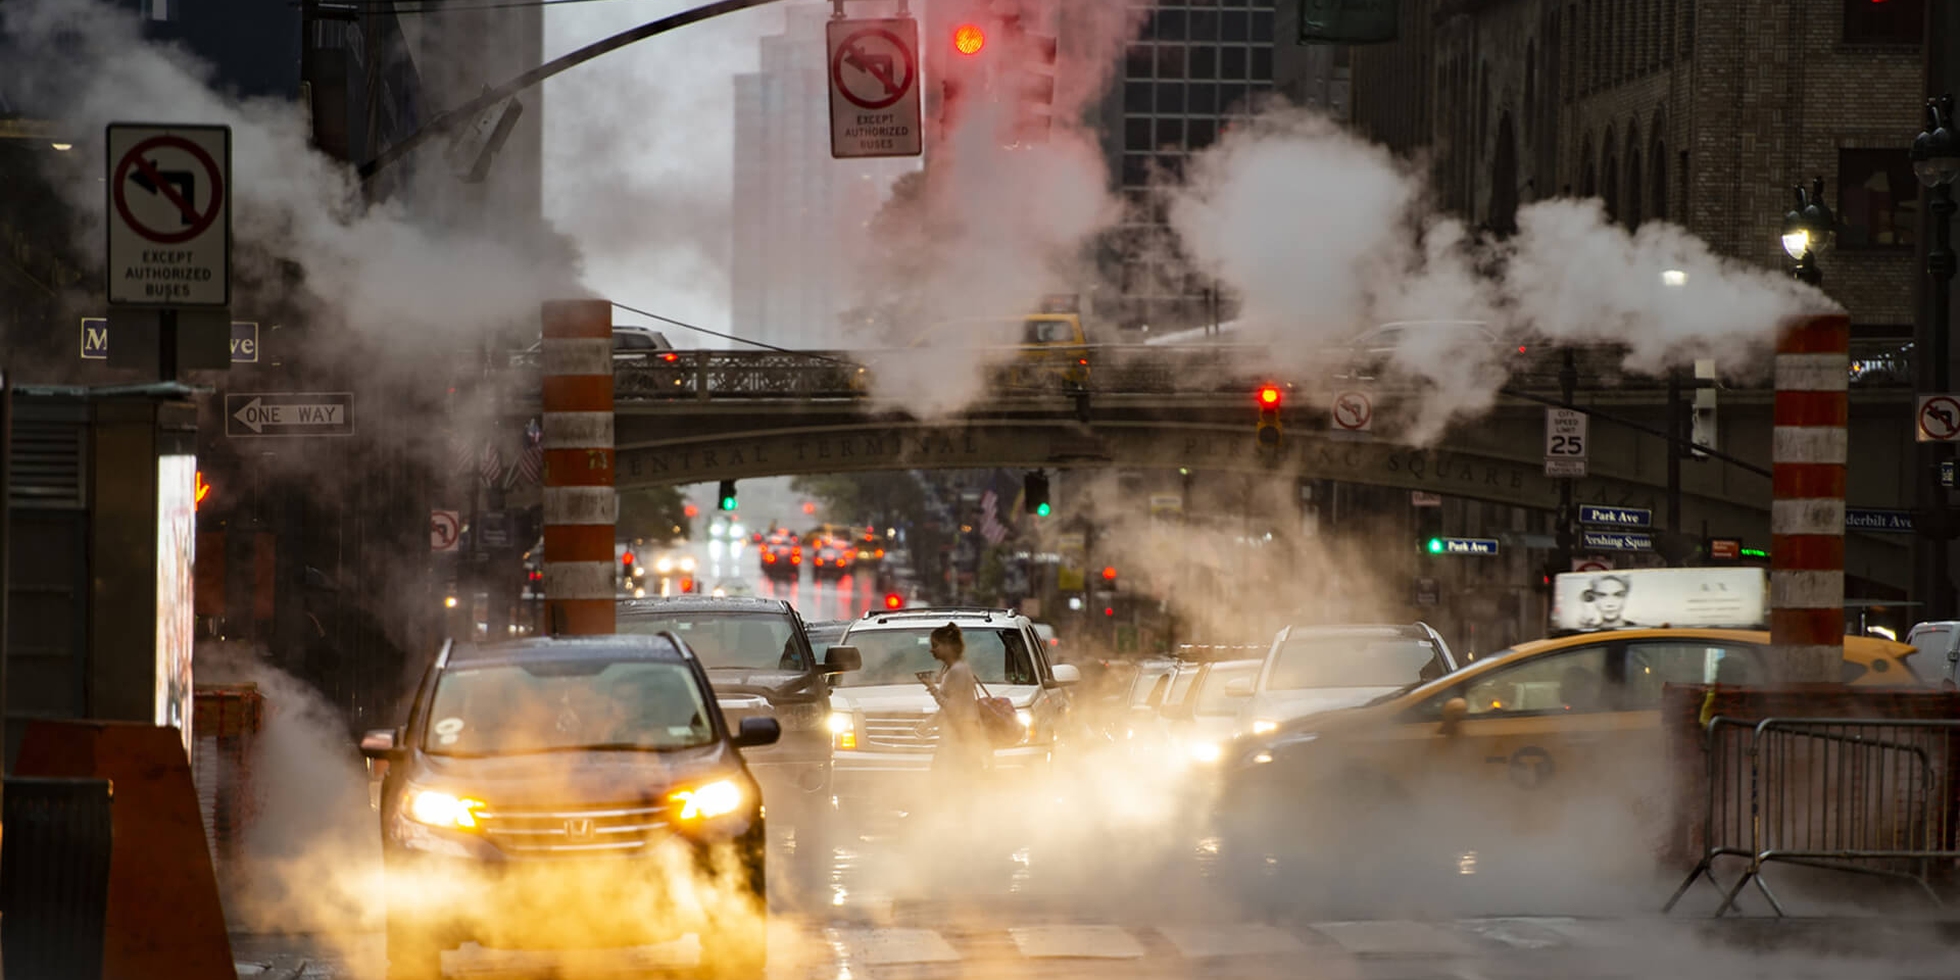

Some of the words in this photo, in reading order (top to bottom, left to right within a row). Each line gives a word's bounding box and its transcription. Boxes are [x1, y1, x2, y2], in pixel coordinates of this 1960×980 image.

[857, 114, 894, 125] EXCEPT
[845, 126, 909, 137] AUTHORIZED
[860, 139, 894, 150] BUSES
[143, 251, 192, 263] EXCEPT
[125, 267, 212, 281] AUTHORIZED
[146, 284, 190, 296] BUSES
[246, 407, 281, 423] ONE
[298, 406, 336, 423] WAY
[1551, 435, 1582, 455] 25
[1388, 453, 1522, 488] SQUARE
[1592, 509, 1617, 521] Park
[1618, 512, 1640, 524] Ave
[1448, 540, 1469, 552] Park
[1470, 541, 1489, 552] Ave
